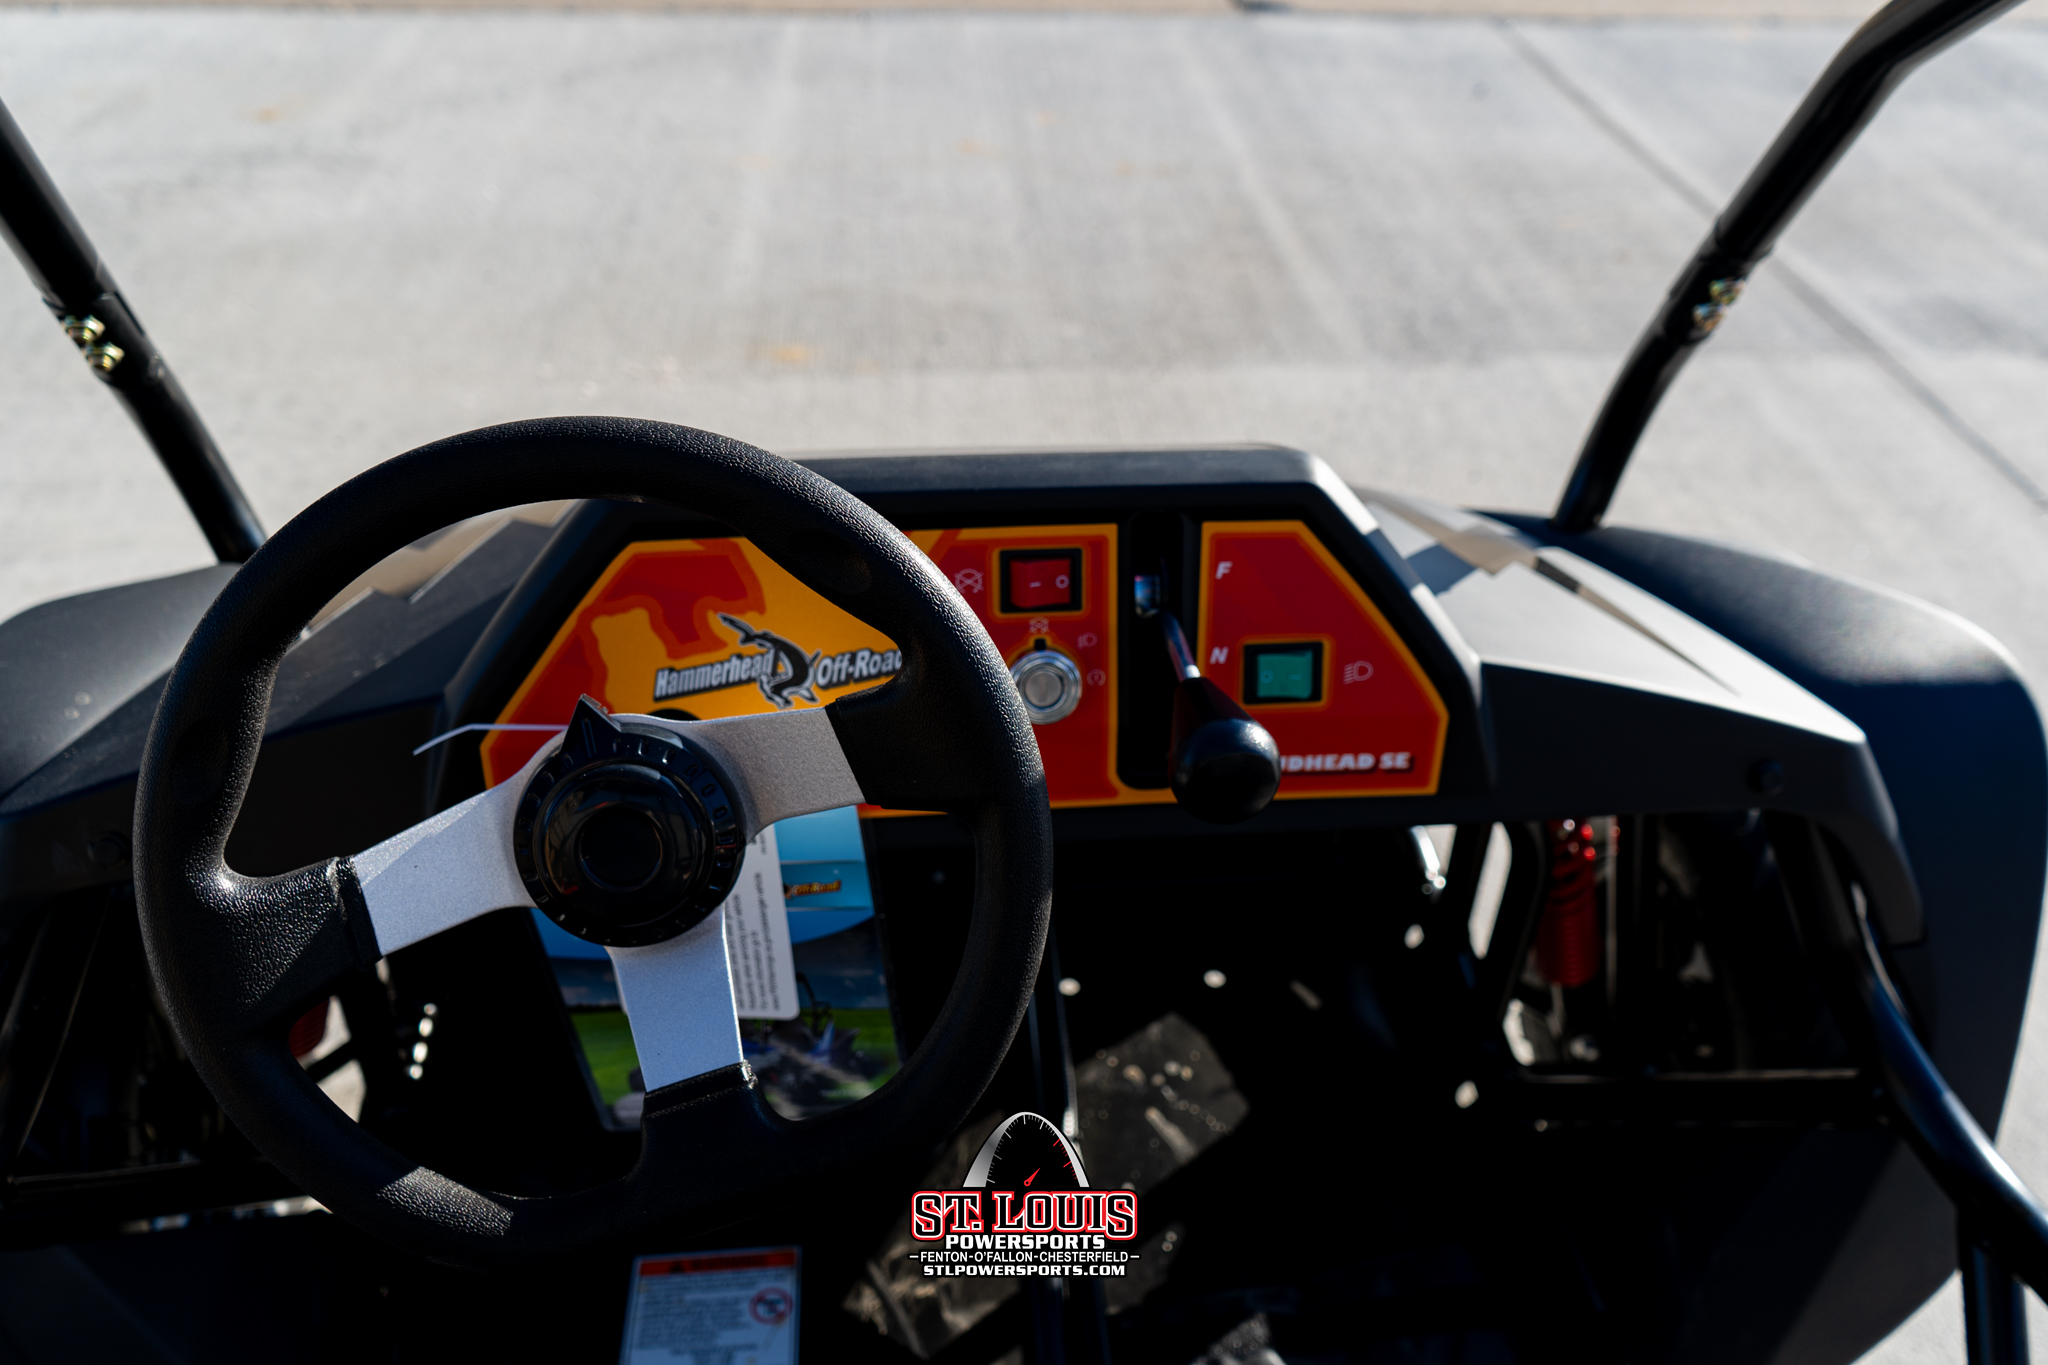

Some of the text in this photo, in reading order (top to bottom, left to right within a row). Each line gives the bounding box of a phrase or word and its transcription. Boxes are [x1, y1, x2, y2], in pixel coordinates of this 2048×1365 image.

[1216, 561, 1233, 579] F
[1210, 647, 1228, 664] N
[654, 650, 776, 699] Hammerhead
[1379, 751, 1411, 770] SE
